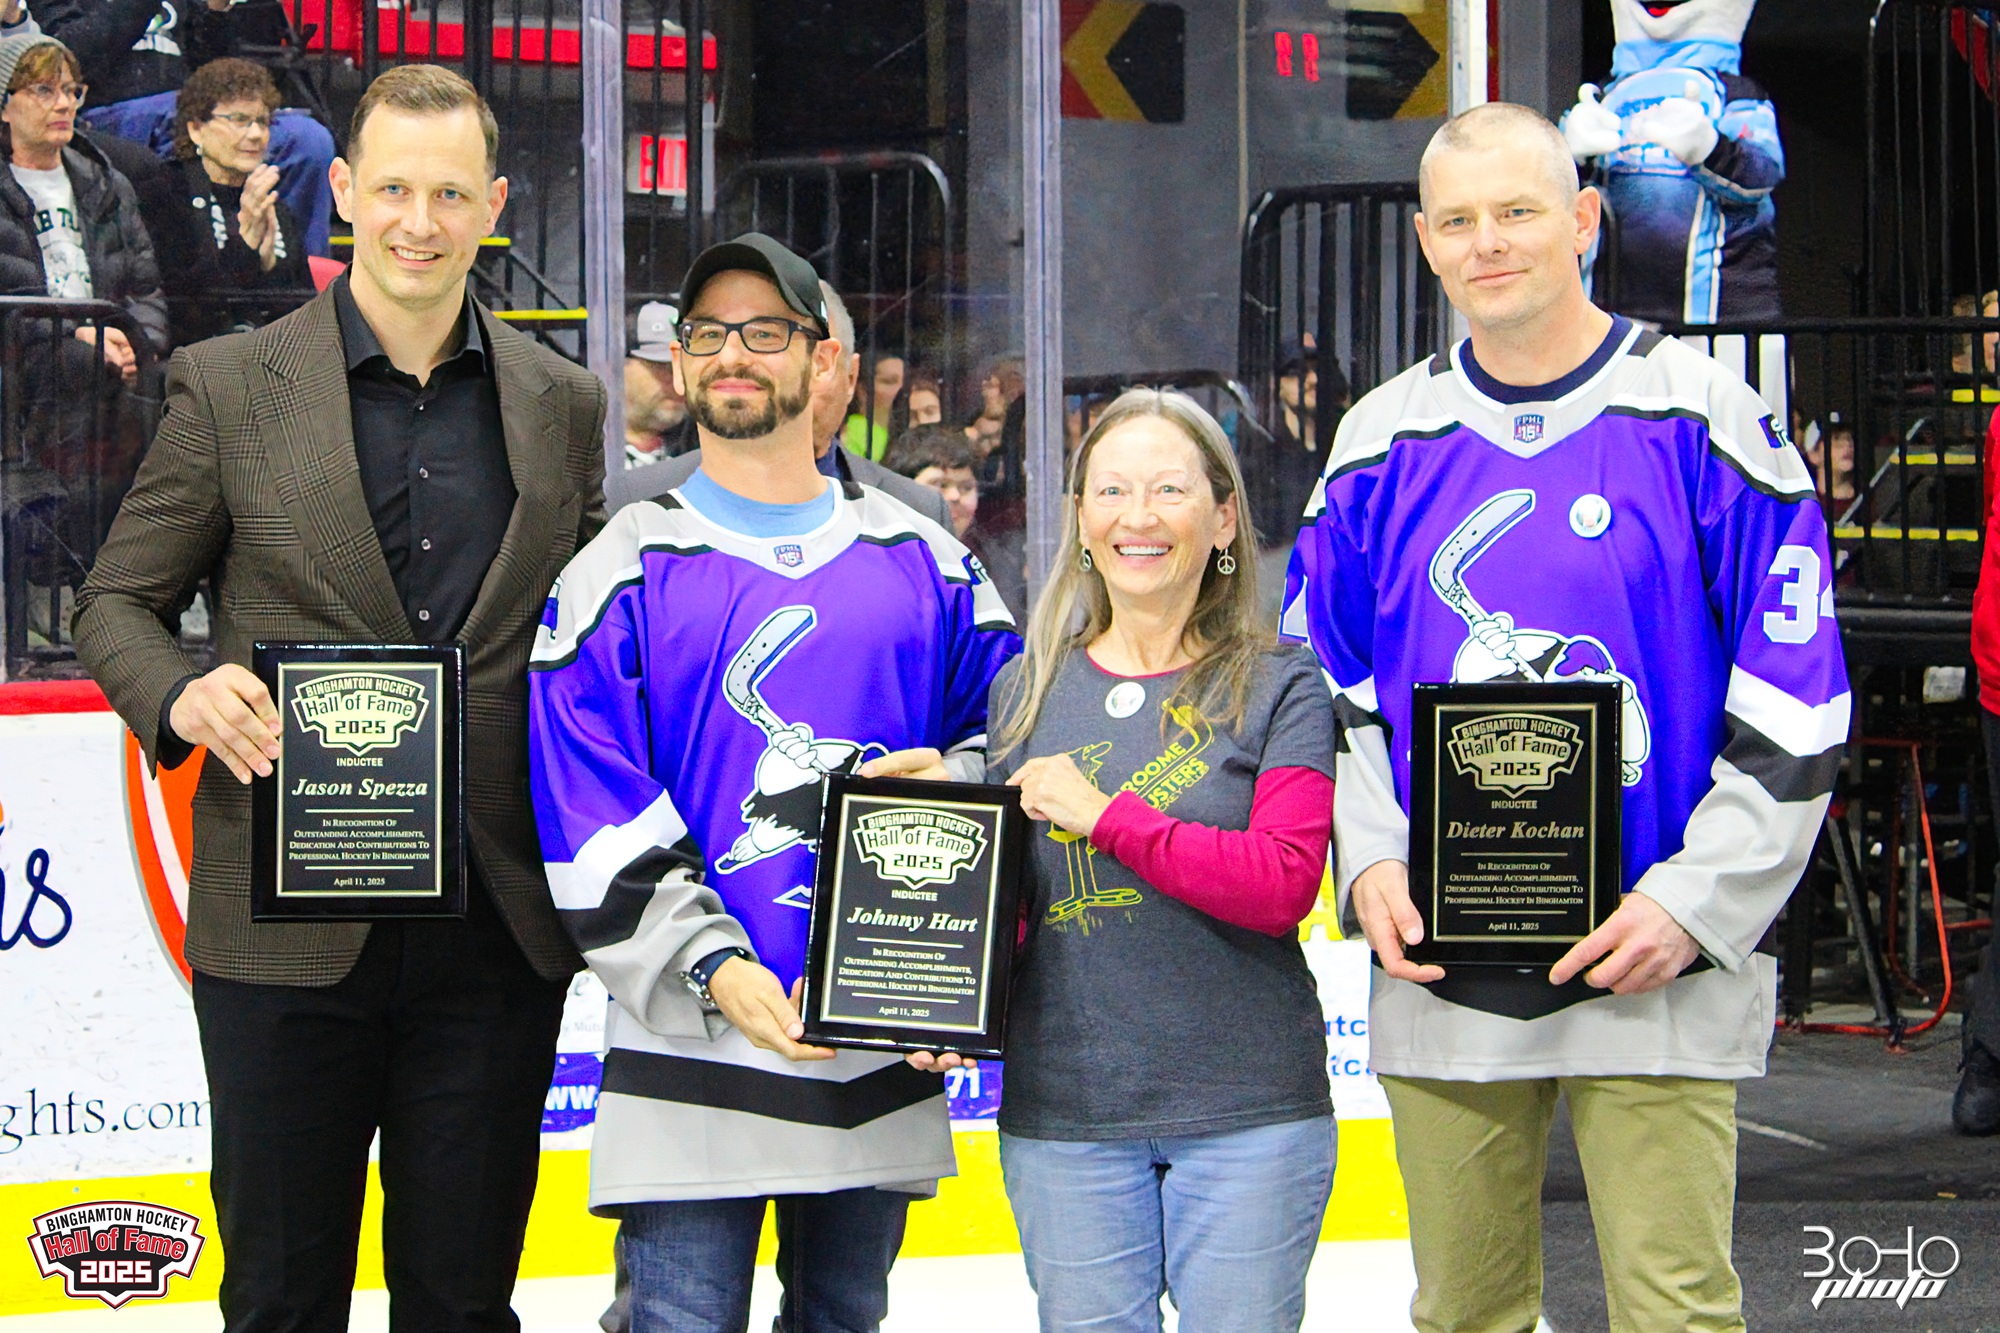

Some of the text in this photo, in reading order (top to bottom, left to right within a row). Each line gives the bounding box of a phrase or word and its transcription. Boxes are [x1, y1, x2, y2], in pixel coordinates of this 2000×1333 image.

[305, 678, 416, 697] BINGHAMTON HOCKEY
[306, 695, 413, 717] Hall of Fame
[335, 721, 386, 733] 2025
[1461, 719, 1570, 738] BINGHAMTON HOCKEY
[1462, 736, 1567, 759] Hall of Fame
[337, 758, 383, 766] INDUCTEE
[1112, 742, 1186, 798] ROOME
[1491, 762, 1541, 775] 2025
[292, 778, 427, 799] Jason Spezza
[1147, 757, 1204, 809] USTERS
[1492, 800, 1537, 809] INDUCTEE
[868, 813, 976, 836] BINGHAMTON HOCKEY
[1446, 821, 1584, 839] Dieter Kochan
[867, 830, 970, 854] Hall of Fame
[894, 854, 943, 869] 2025
[334, 878, 352, 886] April
[892, 890, 937, 901] INDUCTEE
[847, 907, 978, 932] Johnny Hart
[1488, 923, 1507, 931] April
[1509, 923, 1520, 931] 11,
[879, 1006, 929, 1017] April 11, 2025
